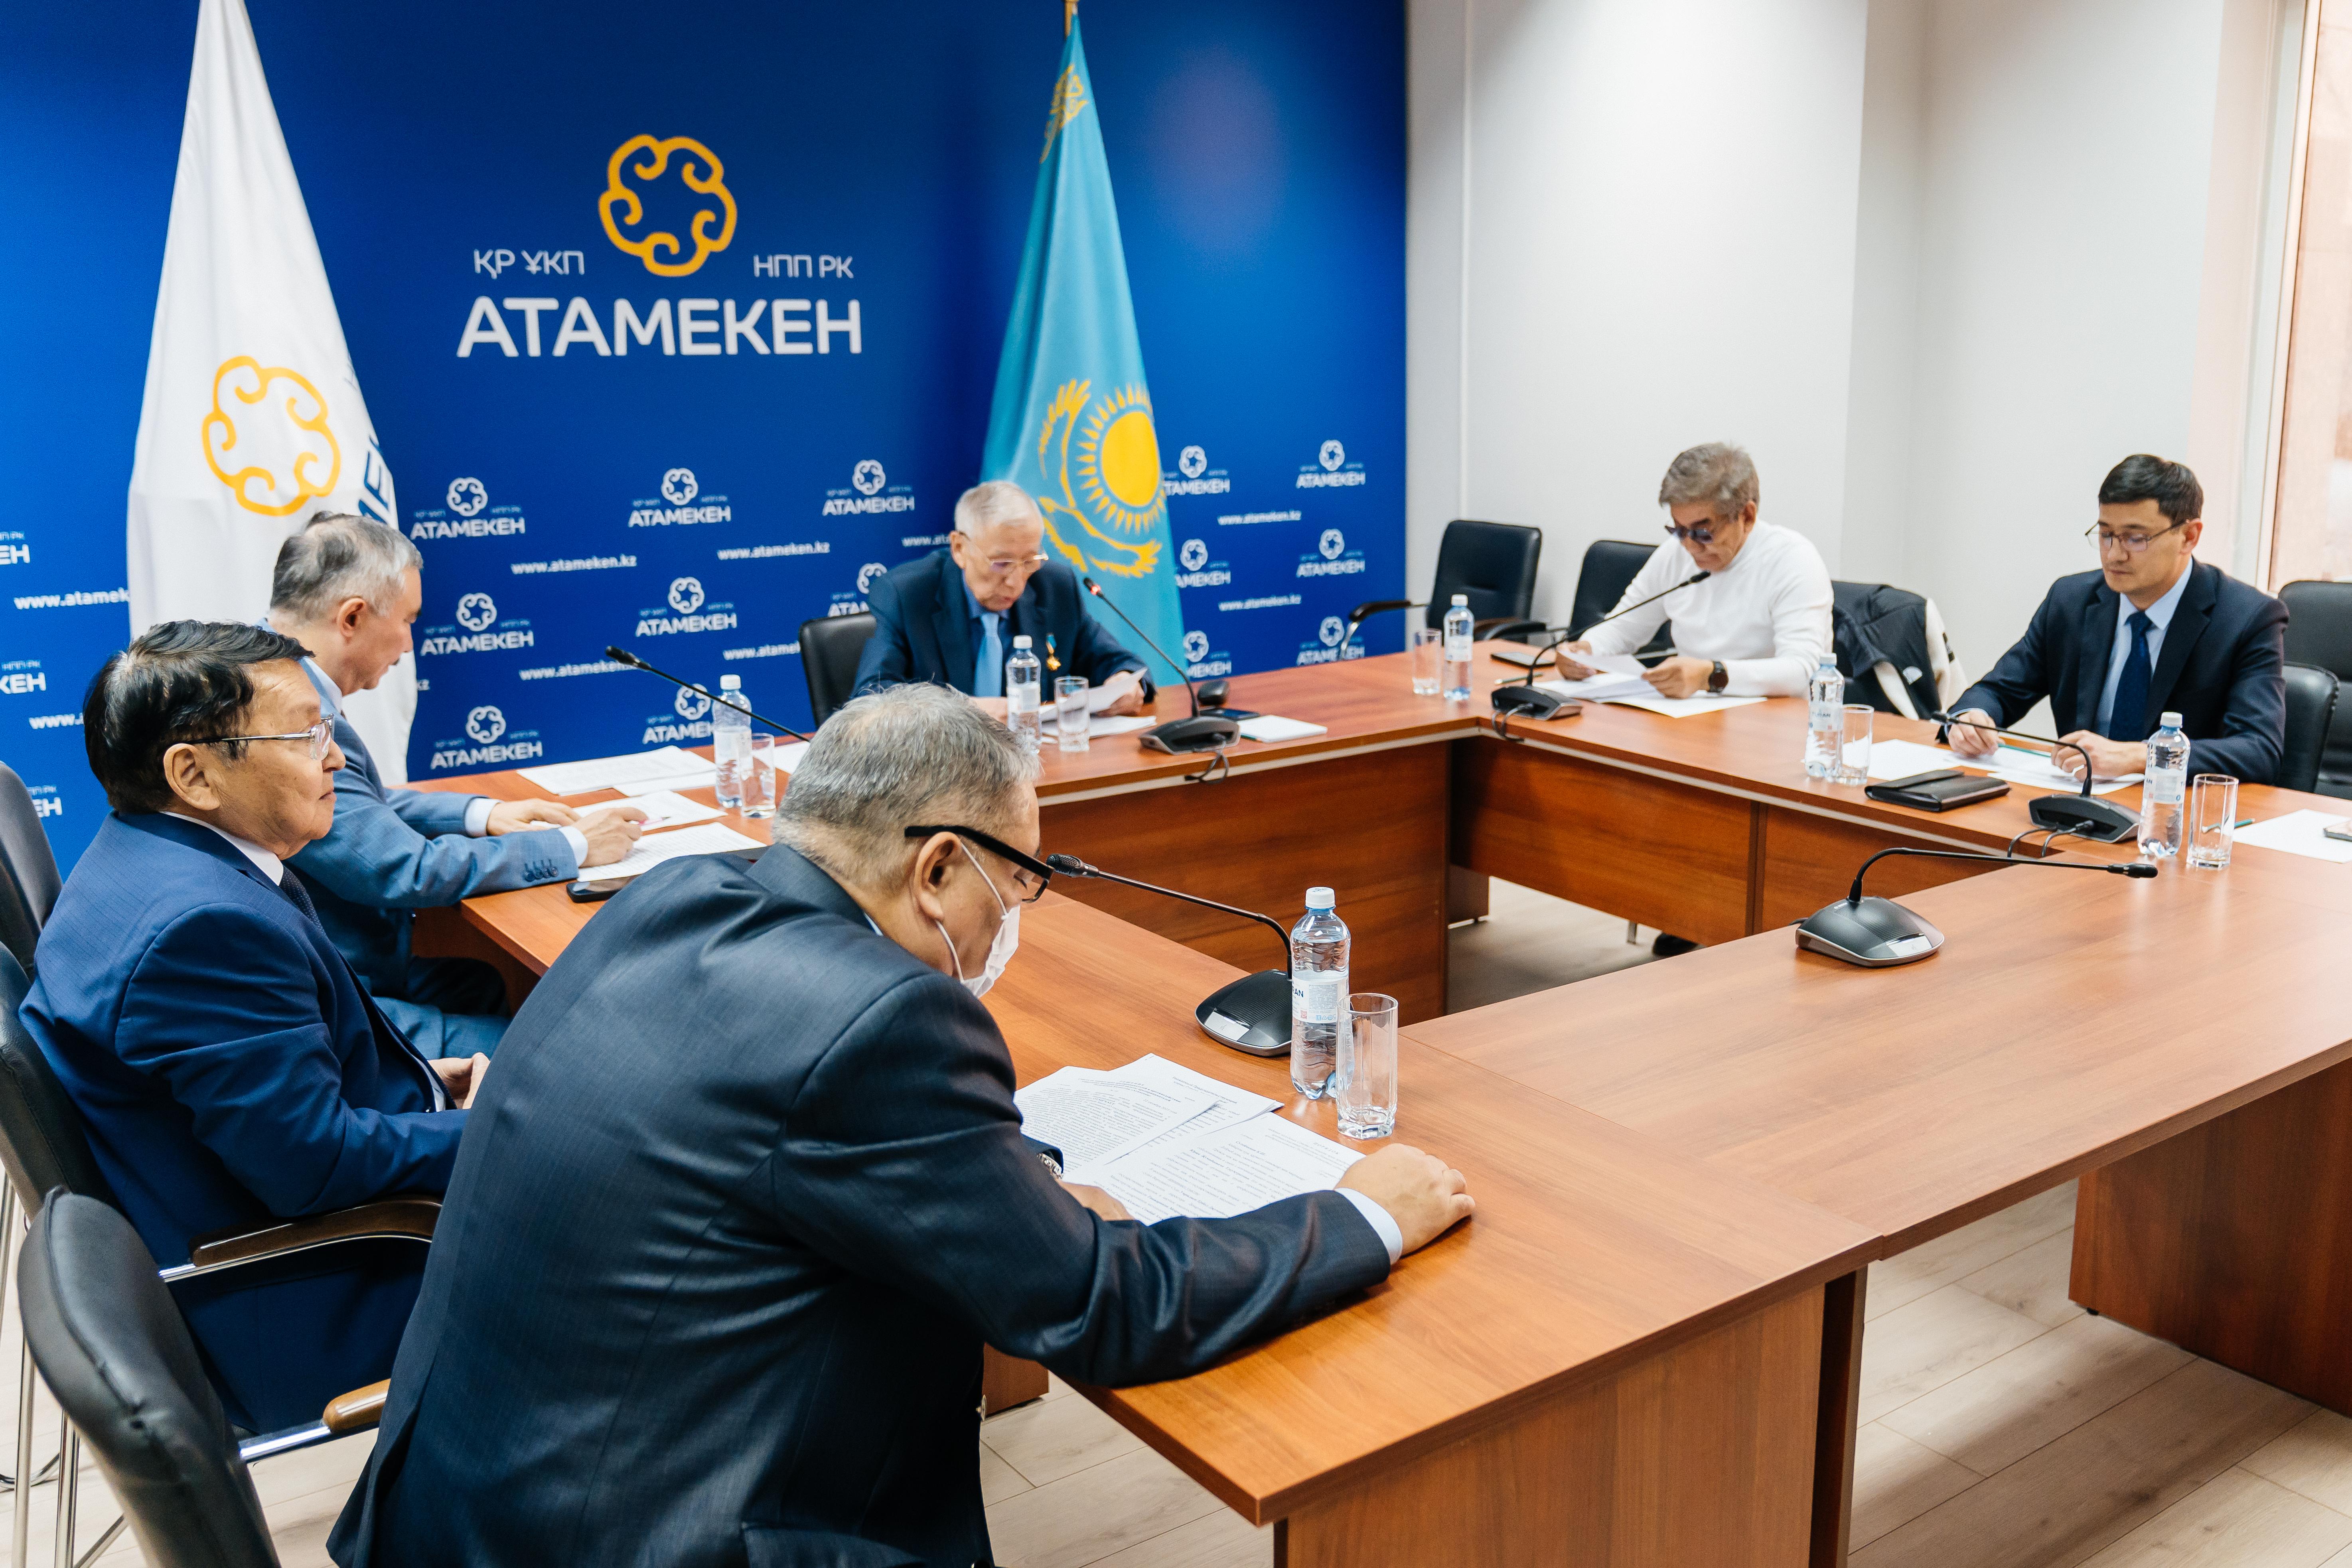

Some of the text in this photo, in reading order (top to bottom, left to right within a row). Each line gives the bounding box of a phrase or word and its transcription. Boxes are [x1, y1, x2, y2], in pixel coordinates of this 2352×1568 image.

[474, 249, 515, 279] ҚР
[753, 254, 854, 278] НПП РК
[457, 296, 862, 357] АТАМЕКЕН
[1164, 478, 1230, 496] ТАМЕКЕН
[1296, 471, 1365, 488] АТАМЕКЕН
[628, 505, 731, 527] АТАМЕКЕН
[822, 495, 915, 516] АТАМЕКЕН
[410, 517, 526, 540] АТАМЕКЕН
[717, 541, 830, 560] www.atameken.kz
[511, 554, 637, 574] www.atameken.kz
[1296, 559, 1365, 577] АТАМЕКЕН
[635, 613, 737, 637] АТАМЕКЕН
[420, 630, 534, 656] АТАМЕКЕН
[431, 741, 543, 769] АТАМЕКЕН
